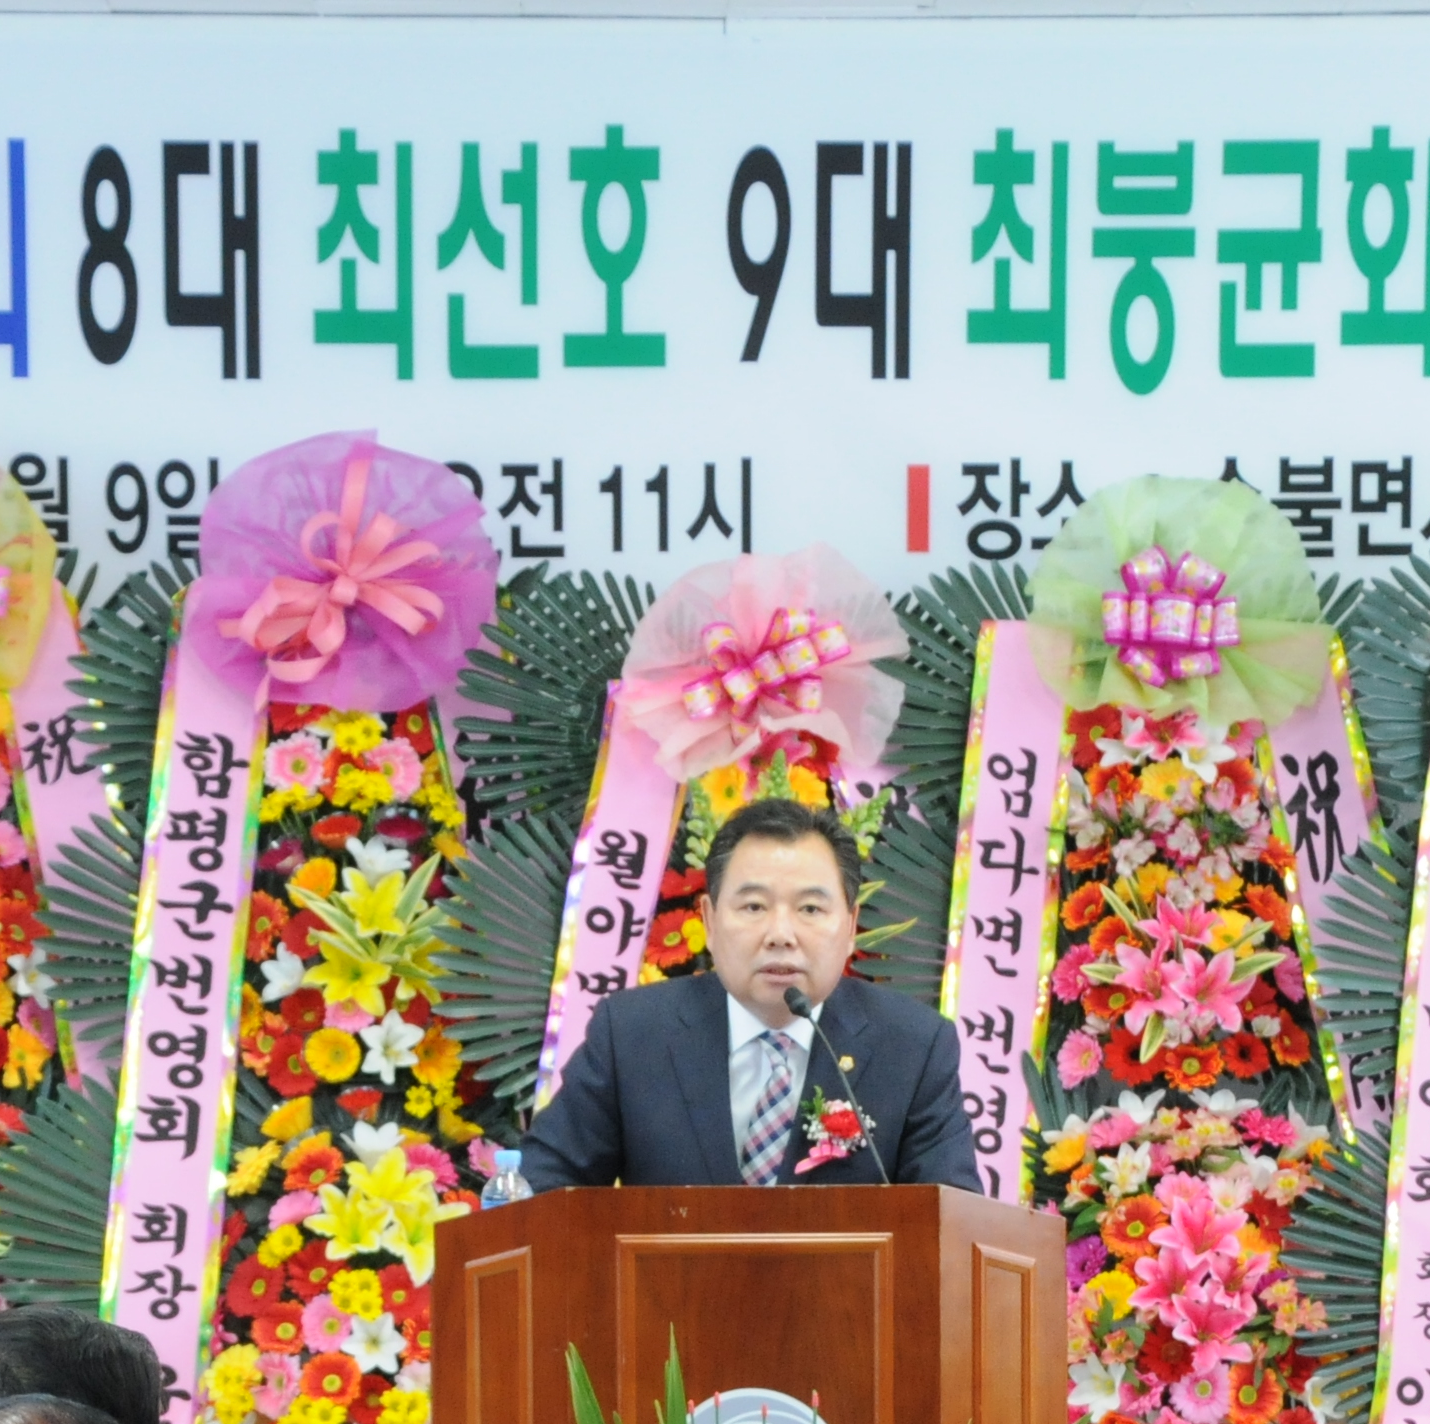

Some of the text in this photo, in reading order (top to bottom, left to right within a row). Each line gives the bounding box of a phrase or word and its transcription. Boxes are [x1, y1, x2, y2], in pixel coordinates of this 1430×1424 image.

[77, 140, 262, 381] 8대
[312, 123, 667, 381] 최선호
[726, 140, 913, 381] 9대
[443, 458, 565, 558] 전
[598, 457, 751, 554] 11시
[20, 714, 97, 786] 祝
[1280, 749, 1356, 885] 祝
[134, 731, 250, 1161] 함평군번영회
[959, 1004, 1015, 1200] 번영
[125, 1202, 198, 1321] 회장
